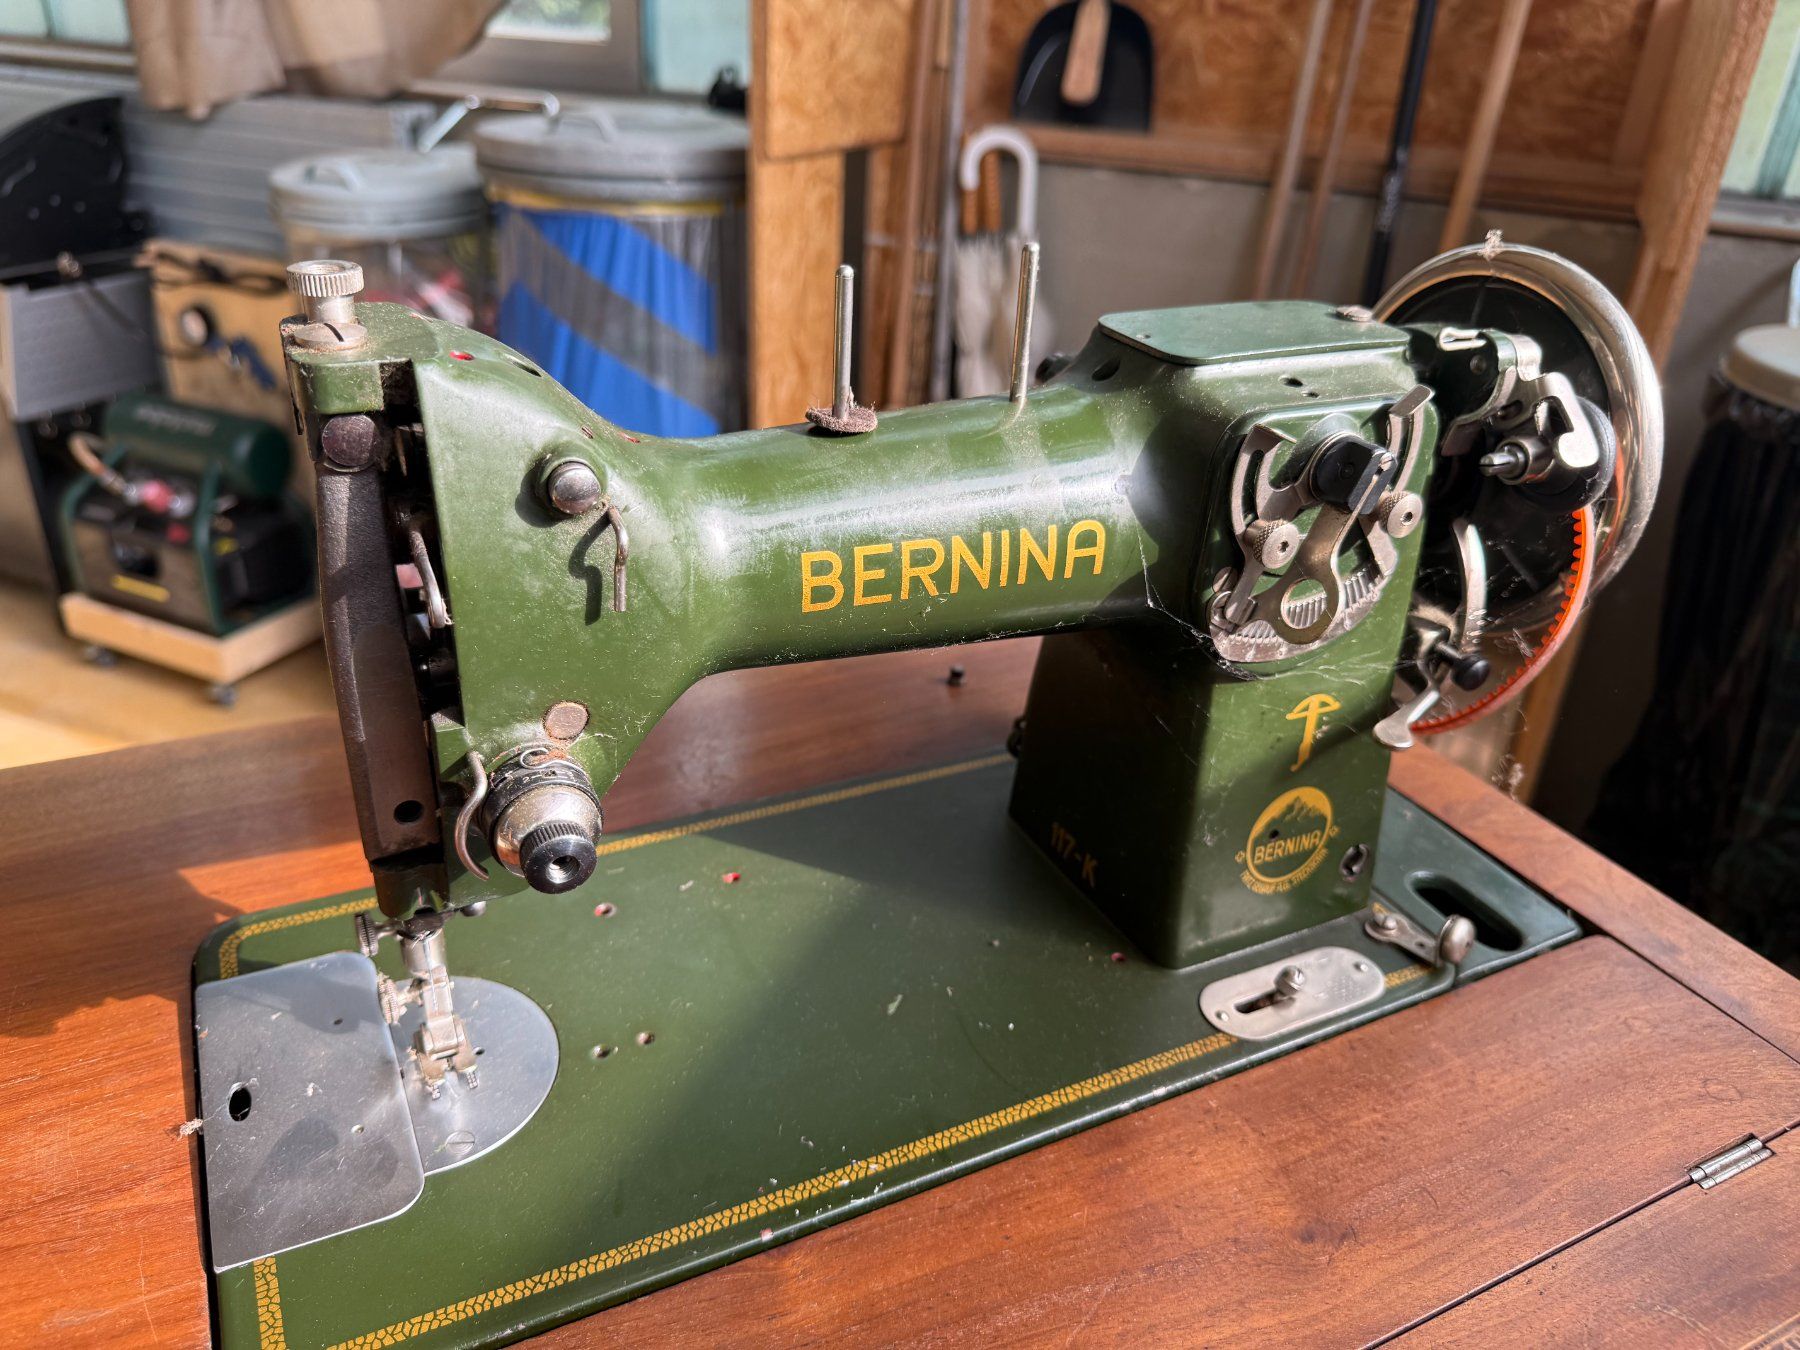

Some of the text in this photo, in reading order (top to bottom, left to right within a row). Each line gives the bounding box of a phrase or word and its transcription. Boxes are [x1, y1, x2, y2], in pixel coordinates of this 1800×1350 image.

[801, 519, 1106, 613] BERNINA
[1050, 821, 1098, 889] 117-K
[1253, 829, 1321, 865] BERNINA
